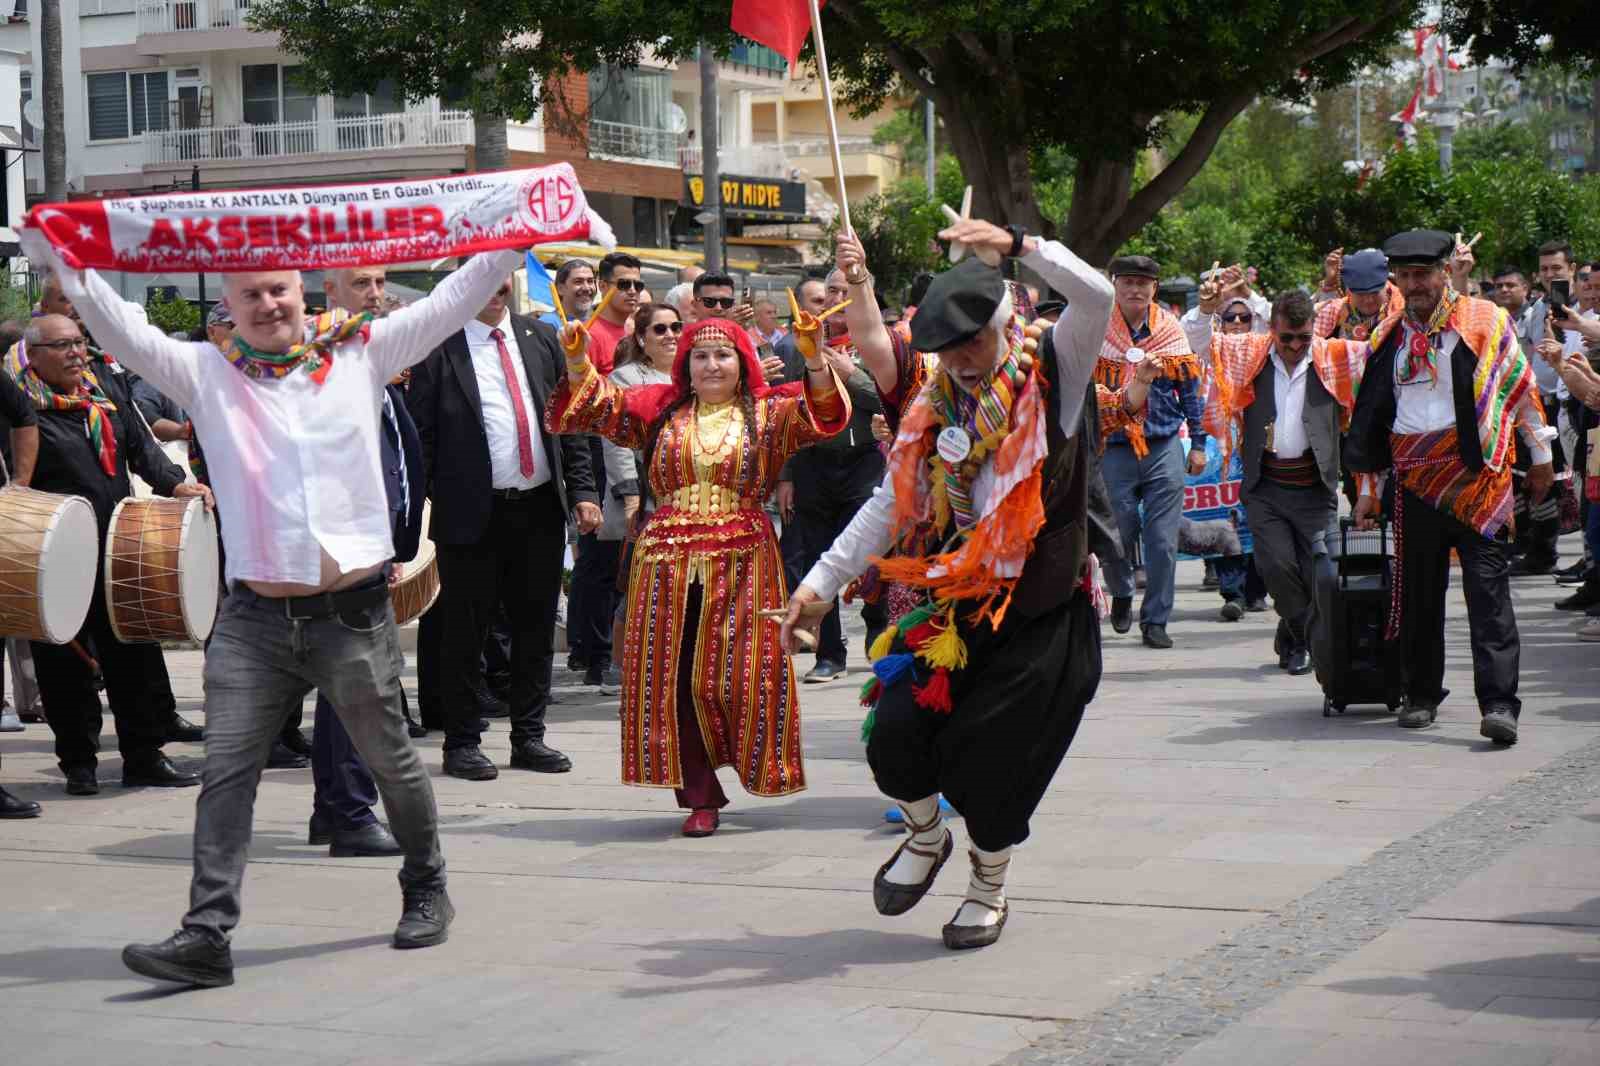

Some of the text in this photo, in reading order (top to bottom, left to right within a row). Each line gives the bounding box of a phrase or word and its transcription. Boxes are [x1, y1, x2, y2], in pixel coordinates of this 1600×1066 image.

[141, 198, 207, 213] Şüphesiz
[232, 192, 298, 208] ANTALYA
[303, 191, 368, 206] Dünyanın
[372, 187, 390, 200] En
[394, 184, 434, 198] Güzel
[722, 181, 739, 204] 07
[148, 203, 448, 250] AKSEKİLİLER
